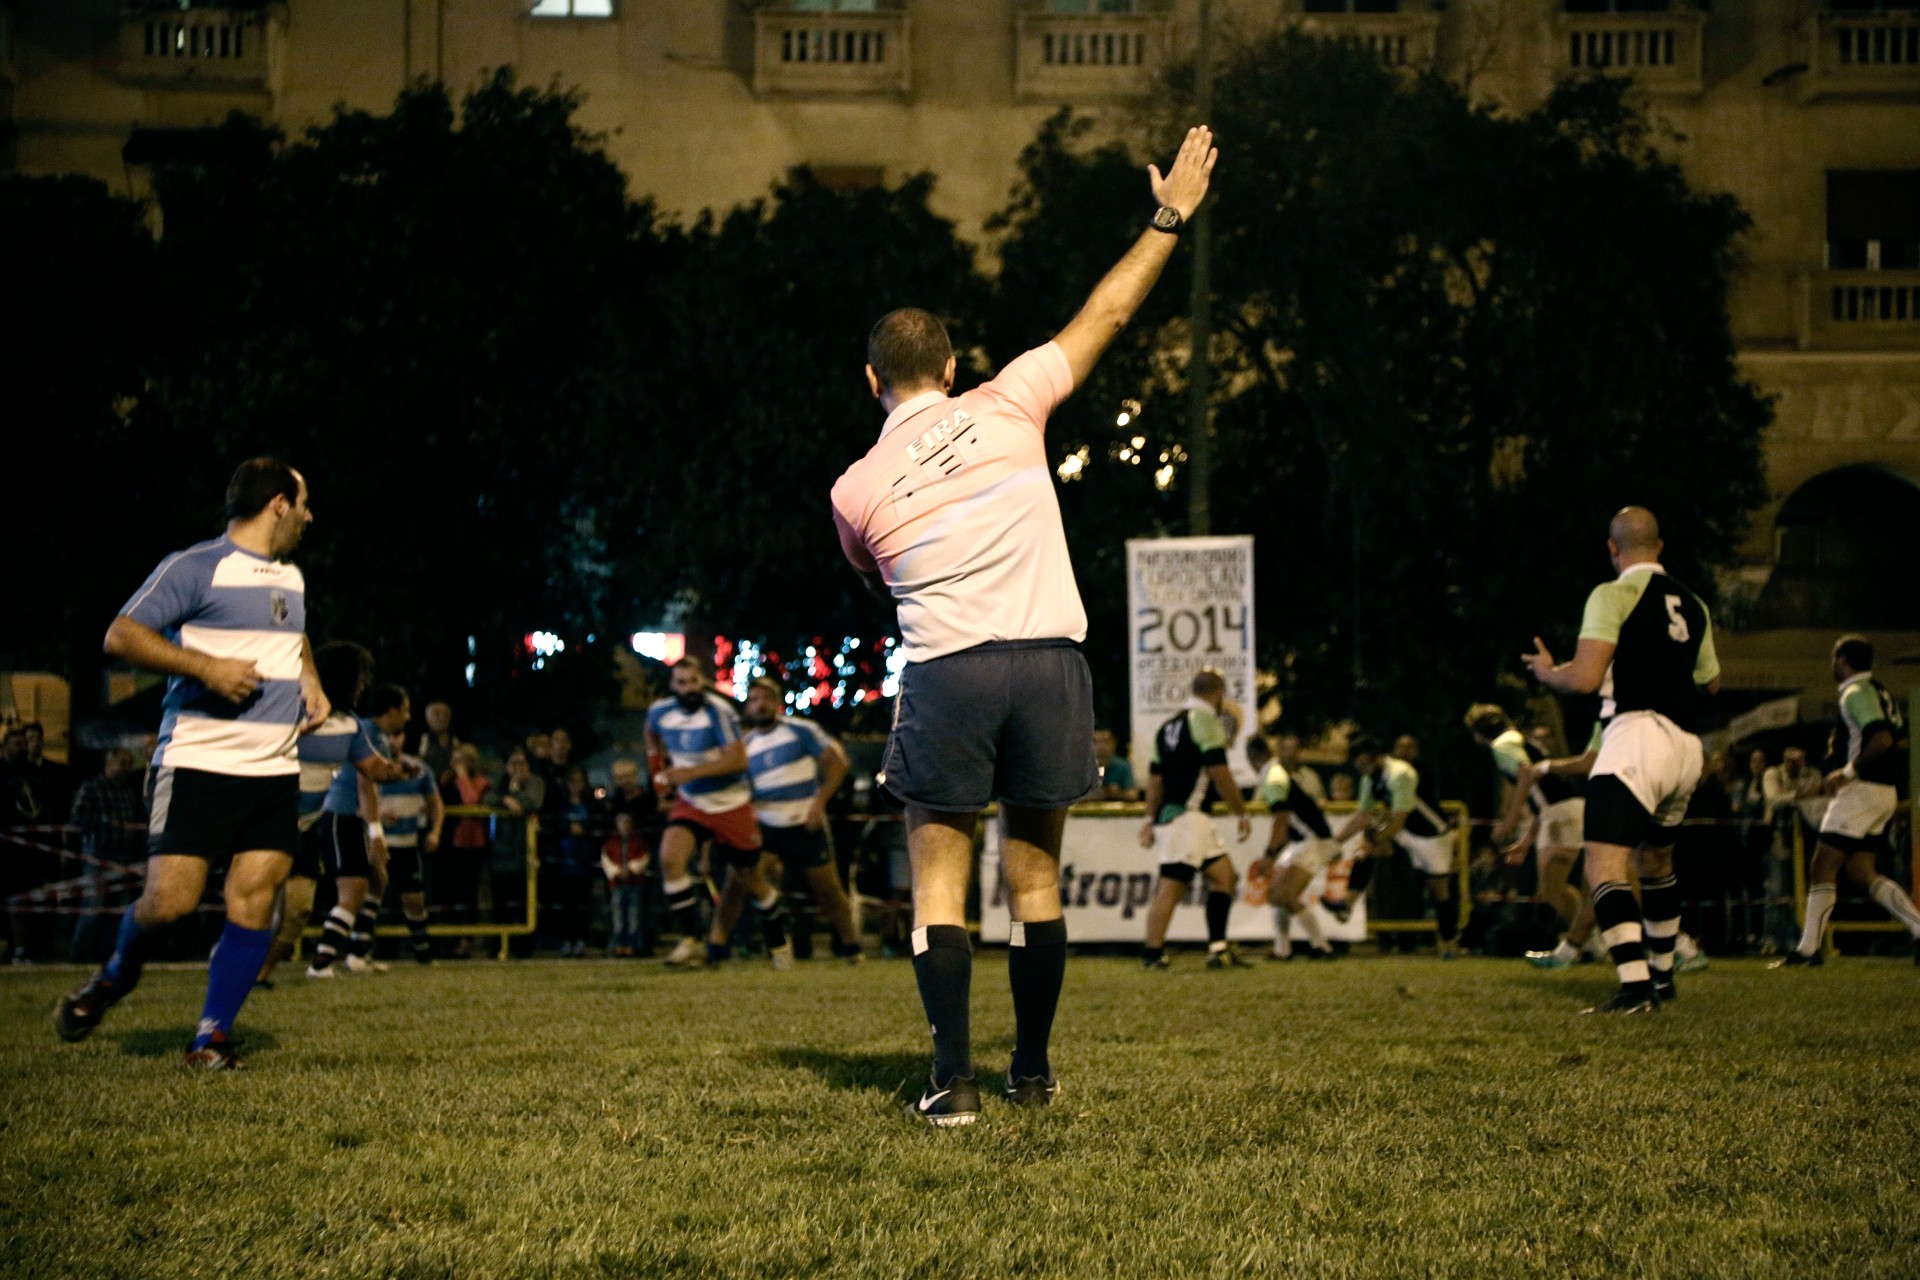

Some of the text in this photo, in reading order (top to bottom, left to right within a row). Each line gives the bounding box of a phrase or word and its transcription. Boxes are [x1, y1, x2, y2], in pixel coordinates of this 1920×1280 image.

[905, 407, 972, 462] FIRA
[1138, 606, 1248, 653] 2014
[1664, 594, 1690, 643] 5
